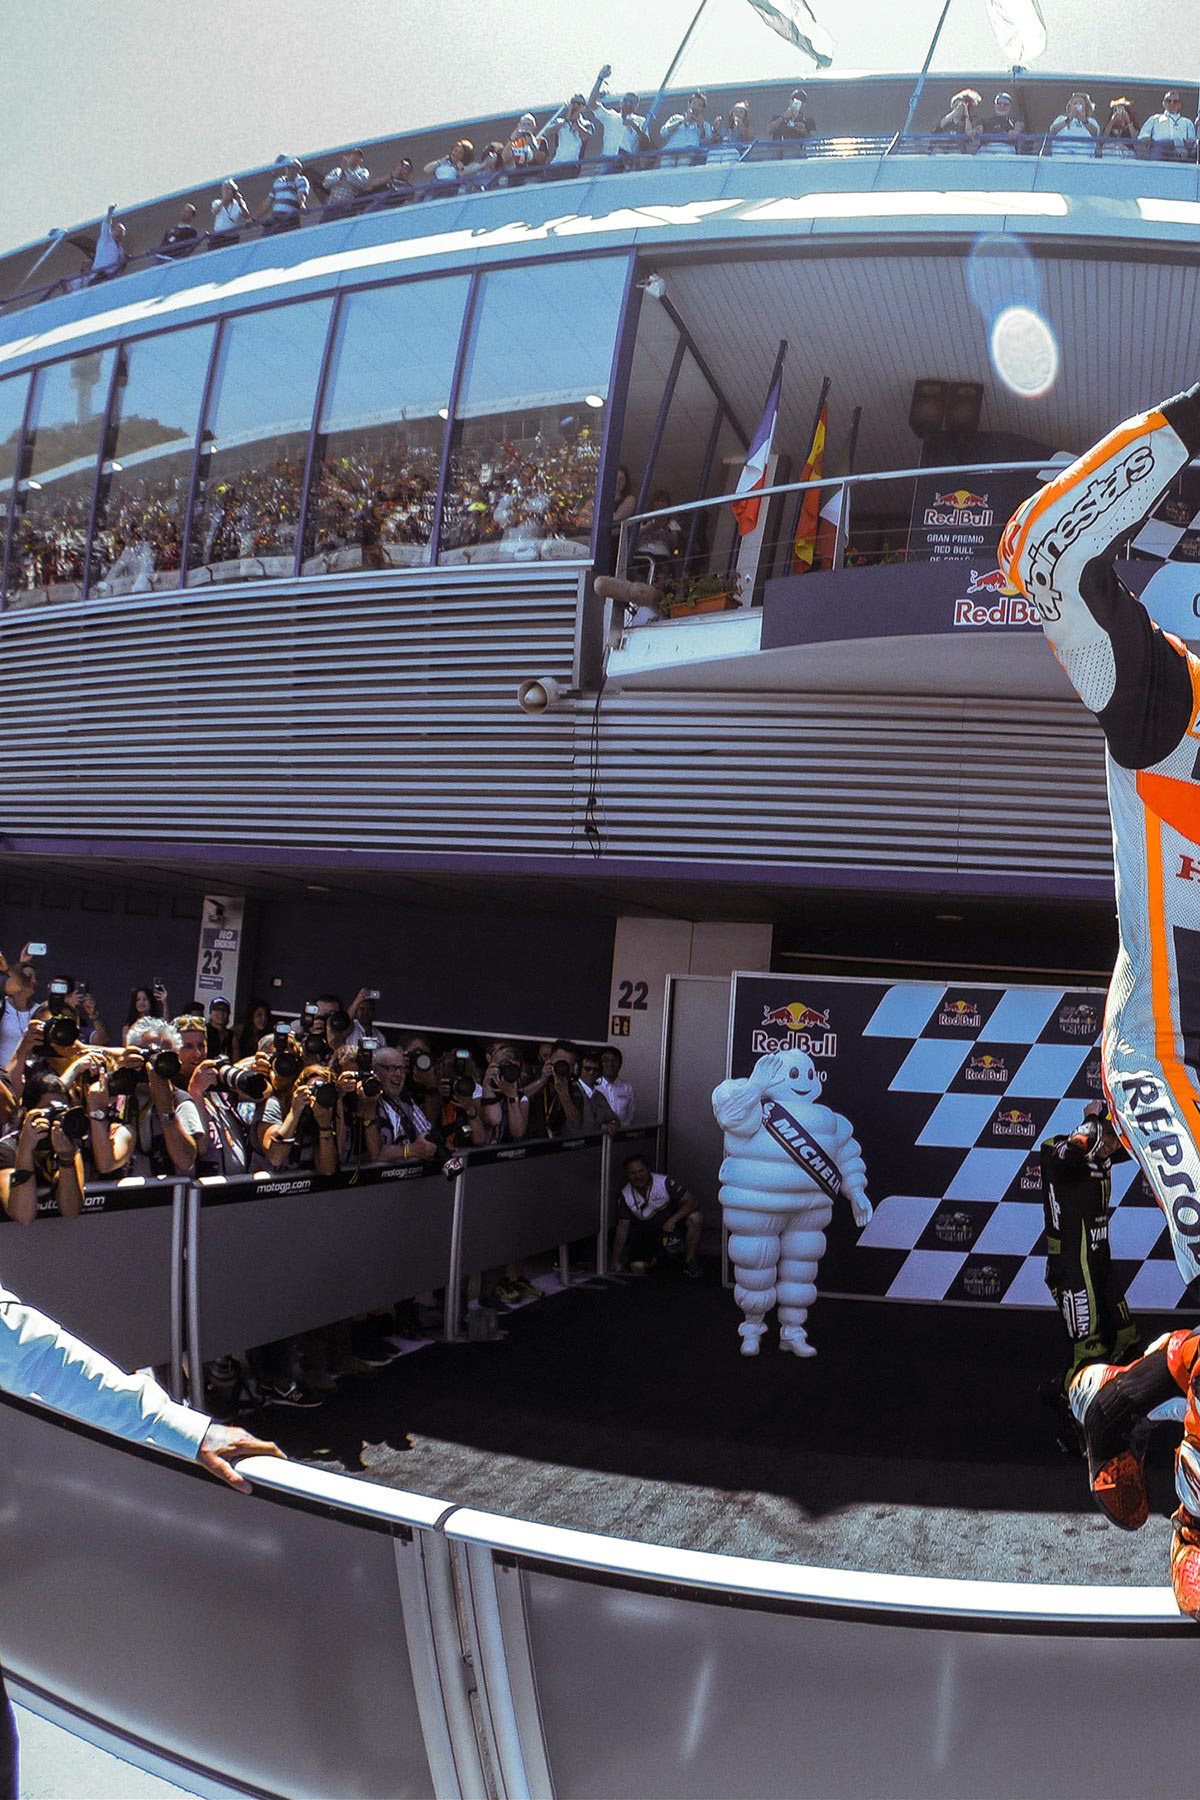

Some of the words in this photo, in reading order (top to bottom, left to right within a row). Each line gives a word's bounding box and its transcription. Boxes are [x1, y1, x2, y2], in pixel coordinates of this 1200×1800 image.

[924, 509, 959, 525] Red
[959, 510, 993, 526] Bull
[927, 534, 949, 543] GRAN
[952, 534, 984, 544] PREMIO
[934, 546, 951, 554] RED
[953, 546, 974, 555] BULL
[954, 597, 1008, 626] Red
[1009, 598, 1043, 626] Bu
[201, 949, 223, 975] 23
[618, 980, 649, 1011] 22
[752, 1030, 794, 1053] Red
[795, 1032, 837, 1057] Bull
[256, 1180, 311, 1195] motogp.com
